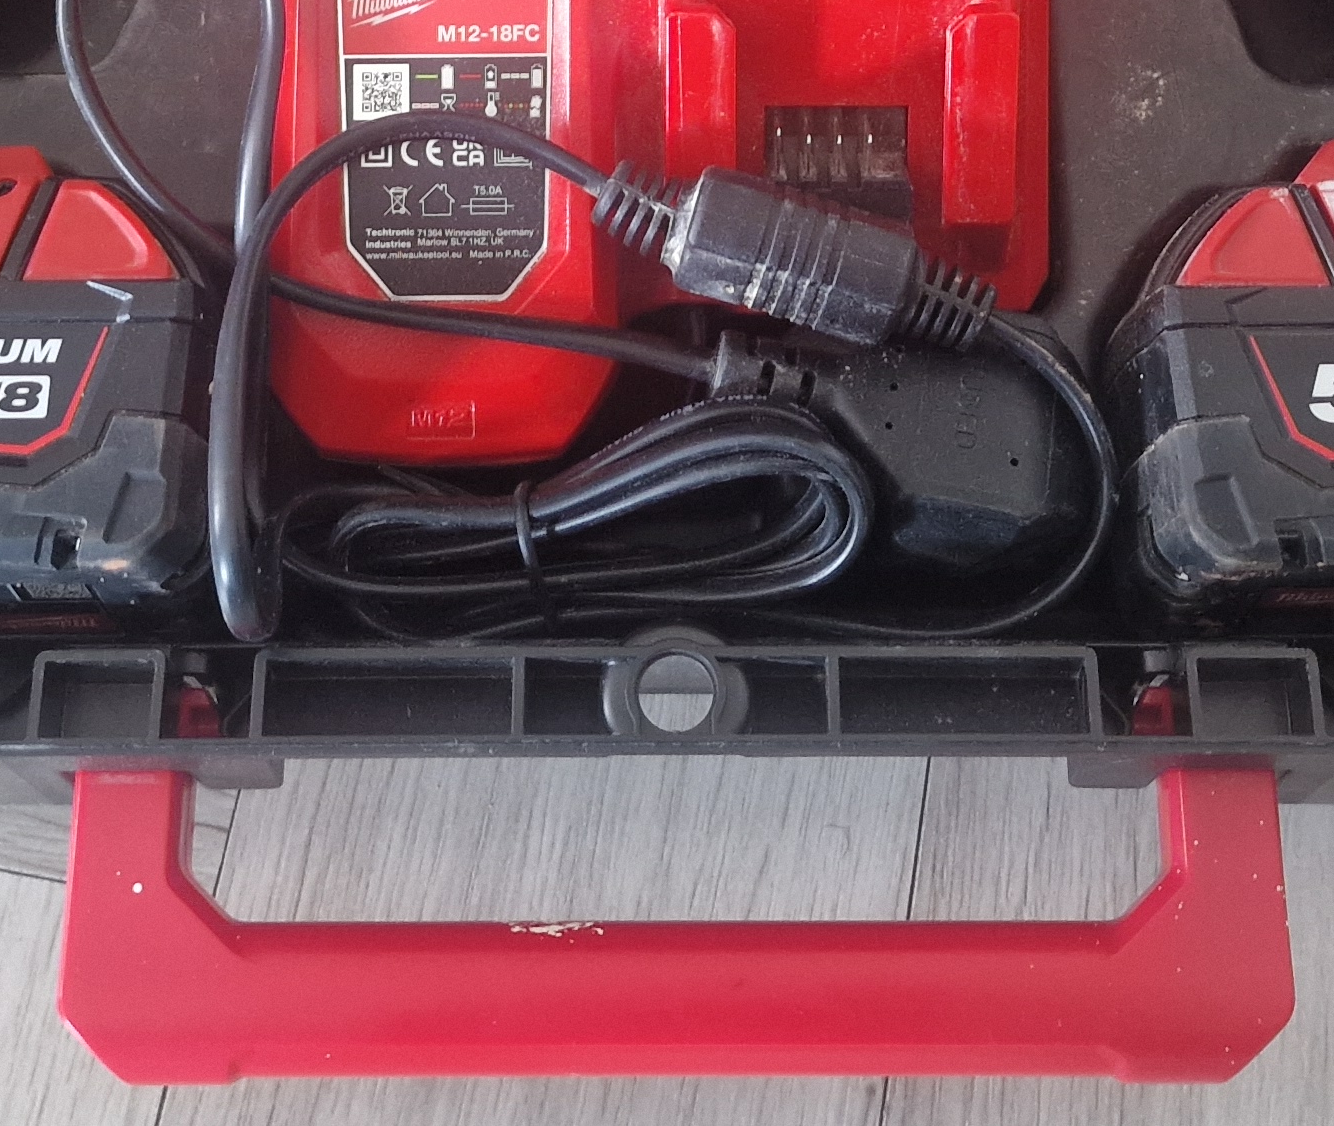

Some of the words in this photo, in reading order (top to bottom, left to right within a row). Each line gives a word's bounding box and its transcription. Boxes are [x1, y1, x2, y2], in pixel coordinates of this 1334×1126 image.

[437, 24, 540, 43] M12-18FC
[452, 151, 485, 167] CA
[473, 185, 503, 196] T5.0A
[366, 228, 414, 237] Techtronic
[497, 227, 534, 238] Germany
[491, 236, 504, 246] UK
[469, 250, 494, 259] Made
[495, 250, 503, 258] in
